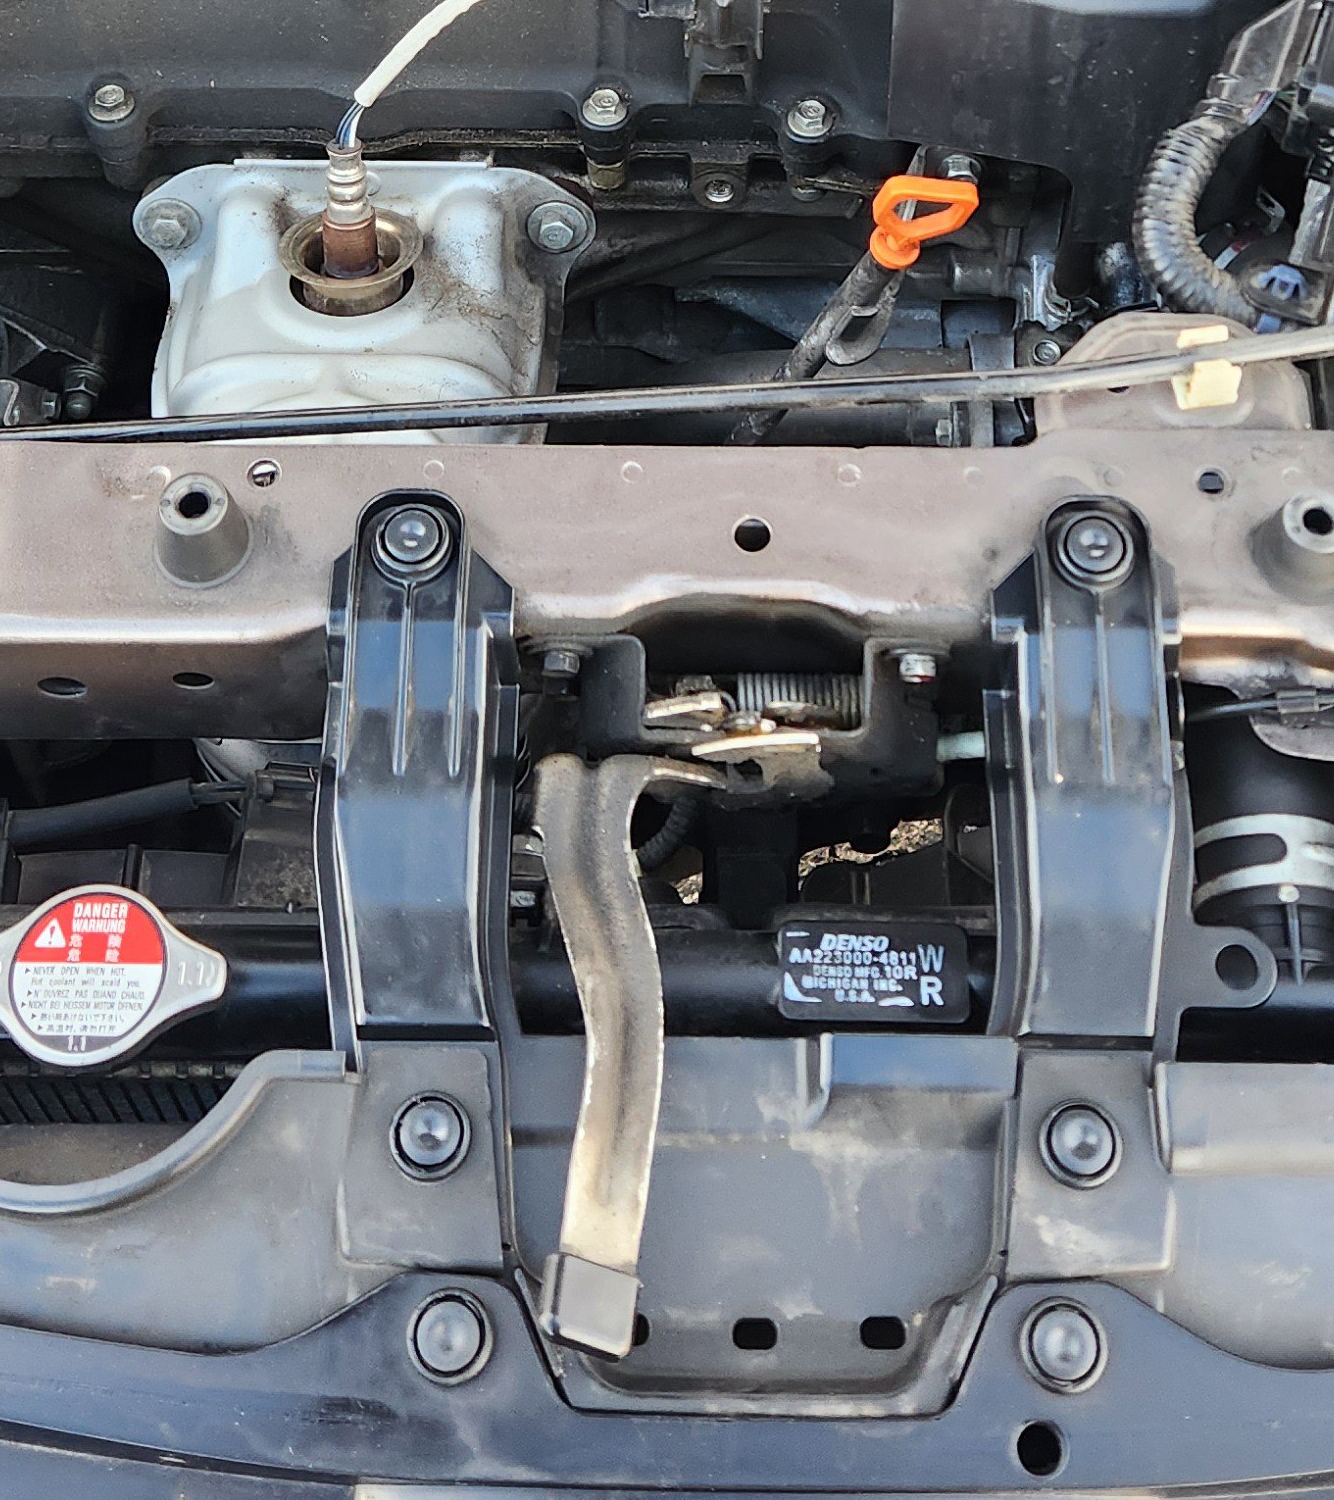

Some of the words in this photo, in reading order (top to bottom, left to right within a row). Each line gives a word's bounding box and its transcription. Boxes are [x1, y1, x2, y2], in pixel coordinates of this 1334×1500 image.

[73, 902, 129, 919] DANGER
[819, 932, 890, 952] DENSO
[917, 943, 945, 974] W
[801, 974, 870, 991] MICHIGAN
[919, 975, 945, 1007] R
[67, 1034, 87, 1052] 1.1
